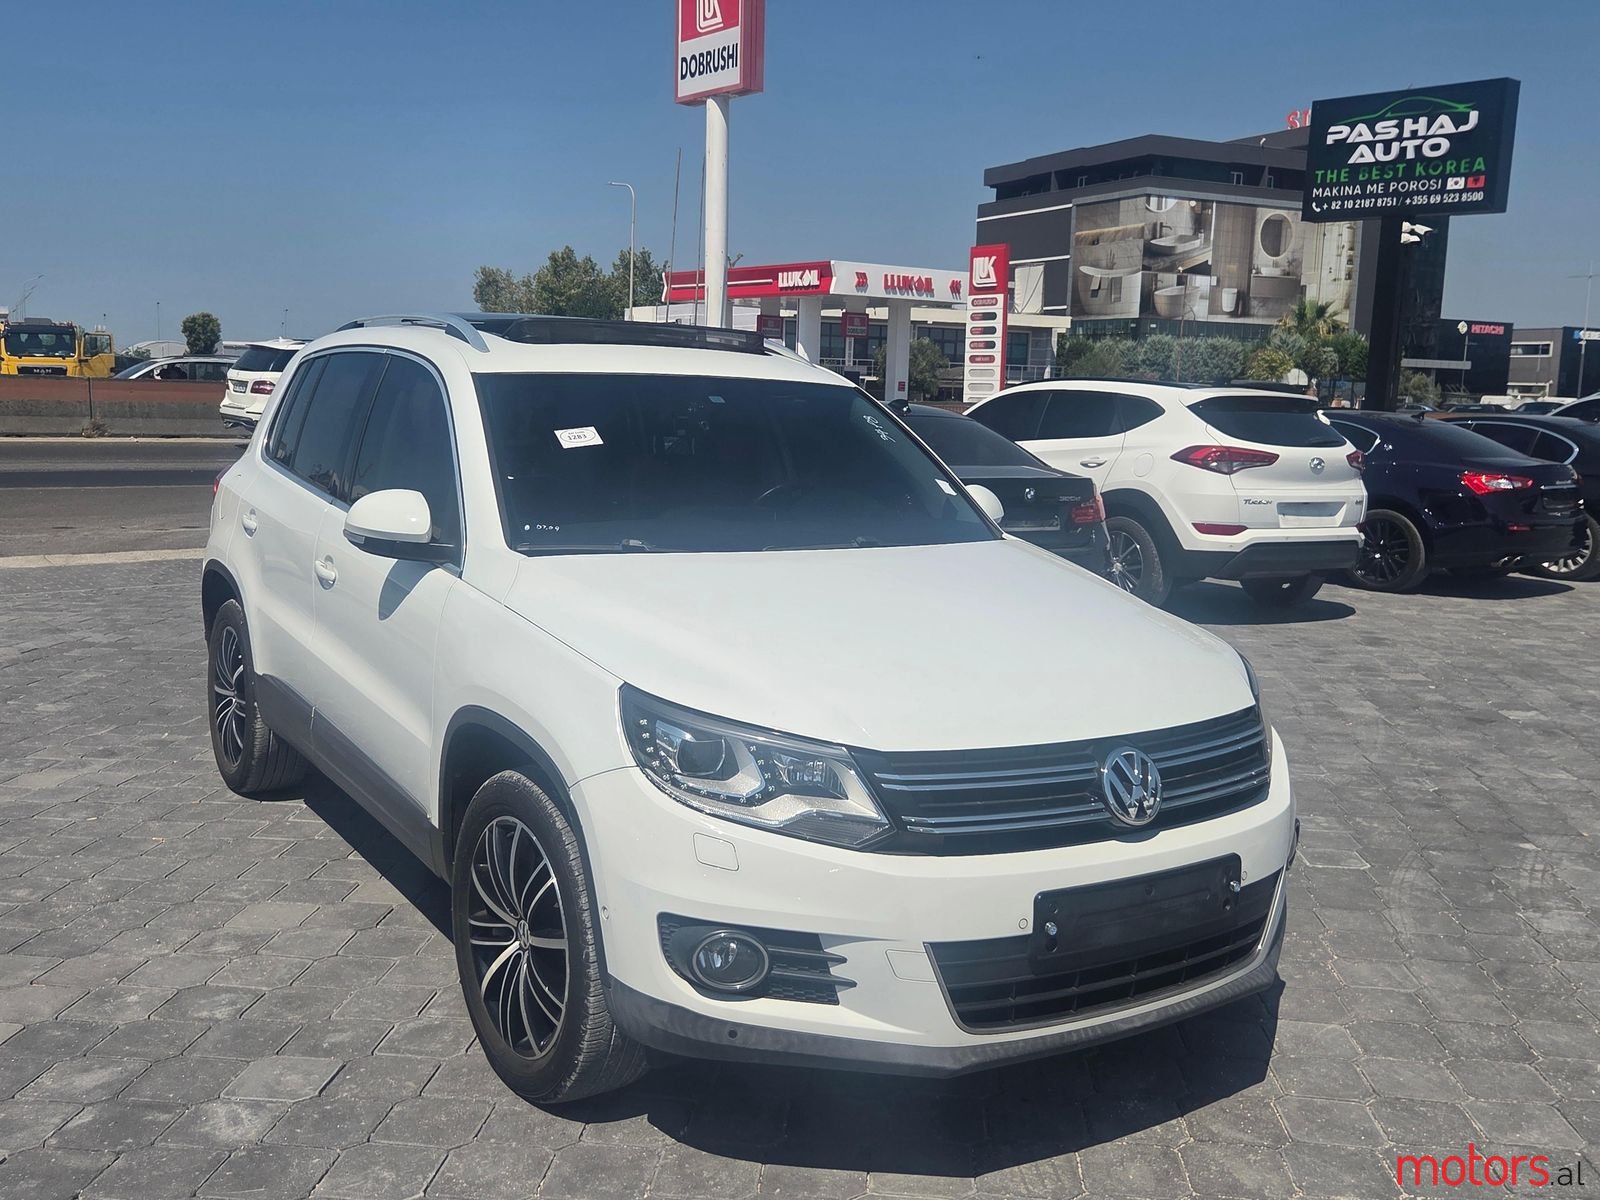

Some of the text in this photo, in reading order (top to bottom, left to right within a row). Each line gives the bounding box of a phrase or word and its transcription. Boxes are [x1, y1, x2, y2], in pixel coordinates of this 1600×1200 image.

[680, 43, 738, 80] DOBRUSHI
[1326, 110, 1479, 144] PASHAJ
[1347, 137, 1451, 164] AUTO
[1315, 157, 1486, 183] THE BEST KOREA
[1312, 178, 1442, 198] MAKINA ME POROSI
[1471, 324, 1504, 335] HITACHI
